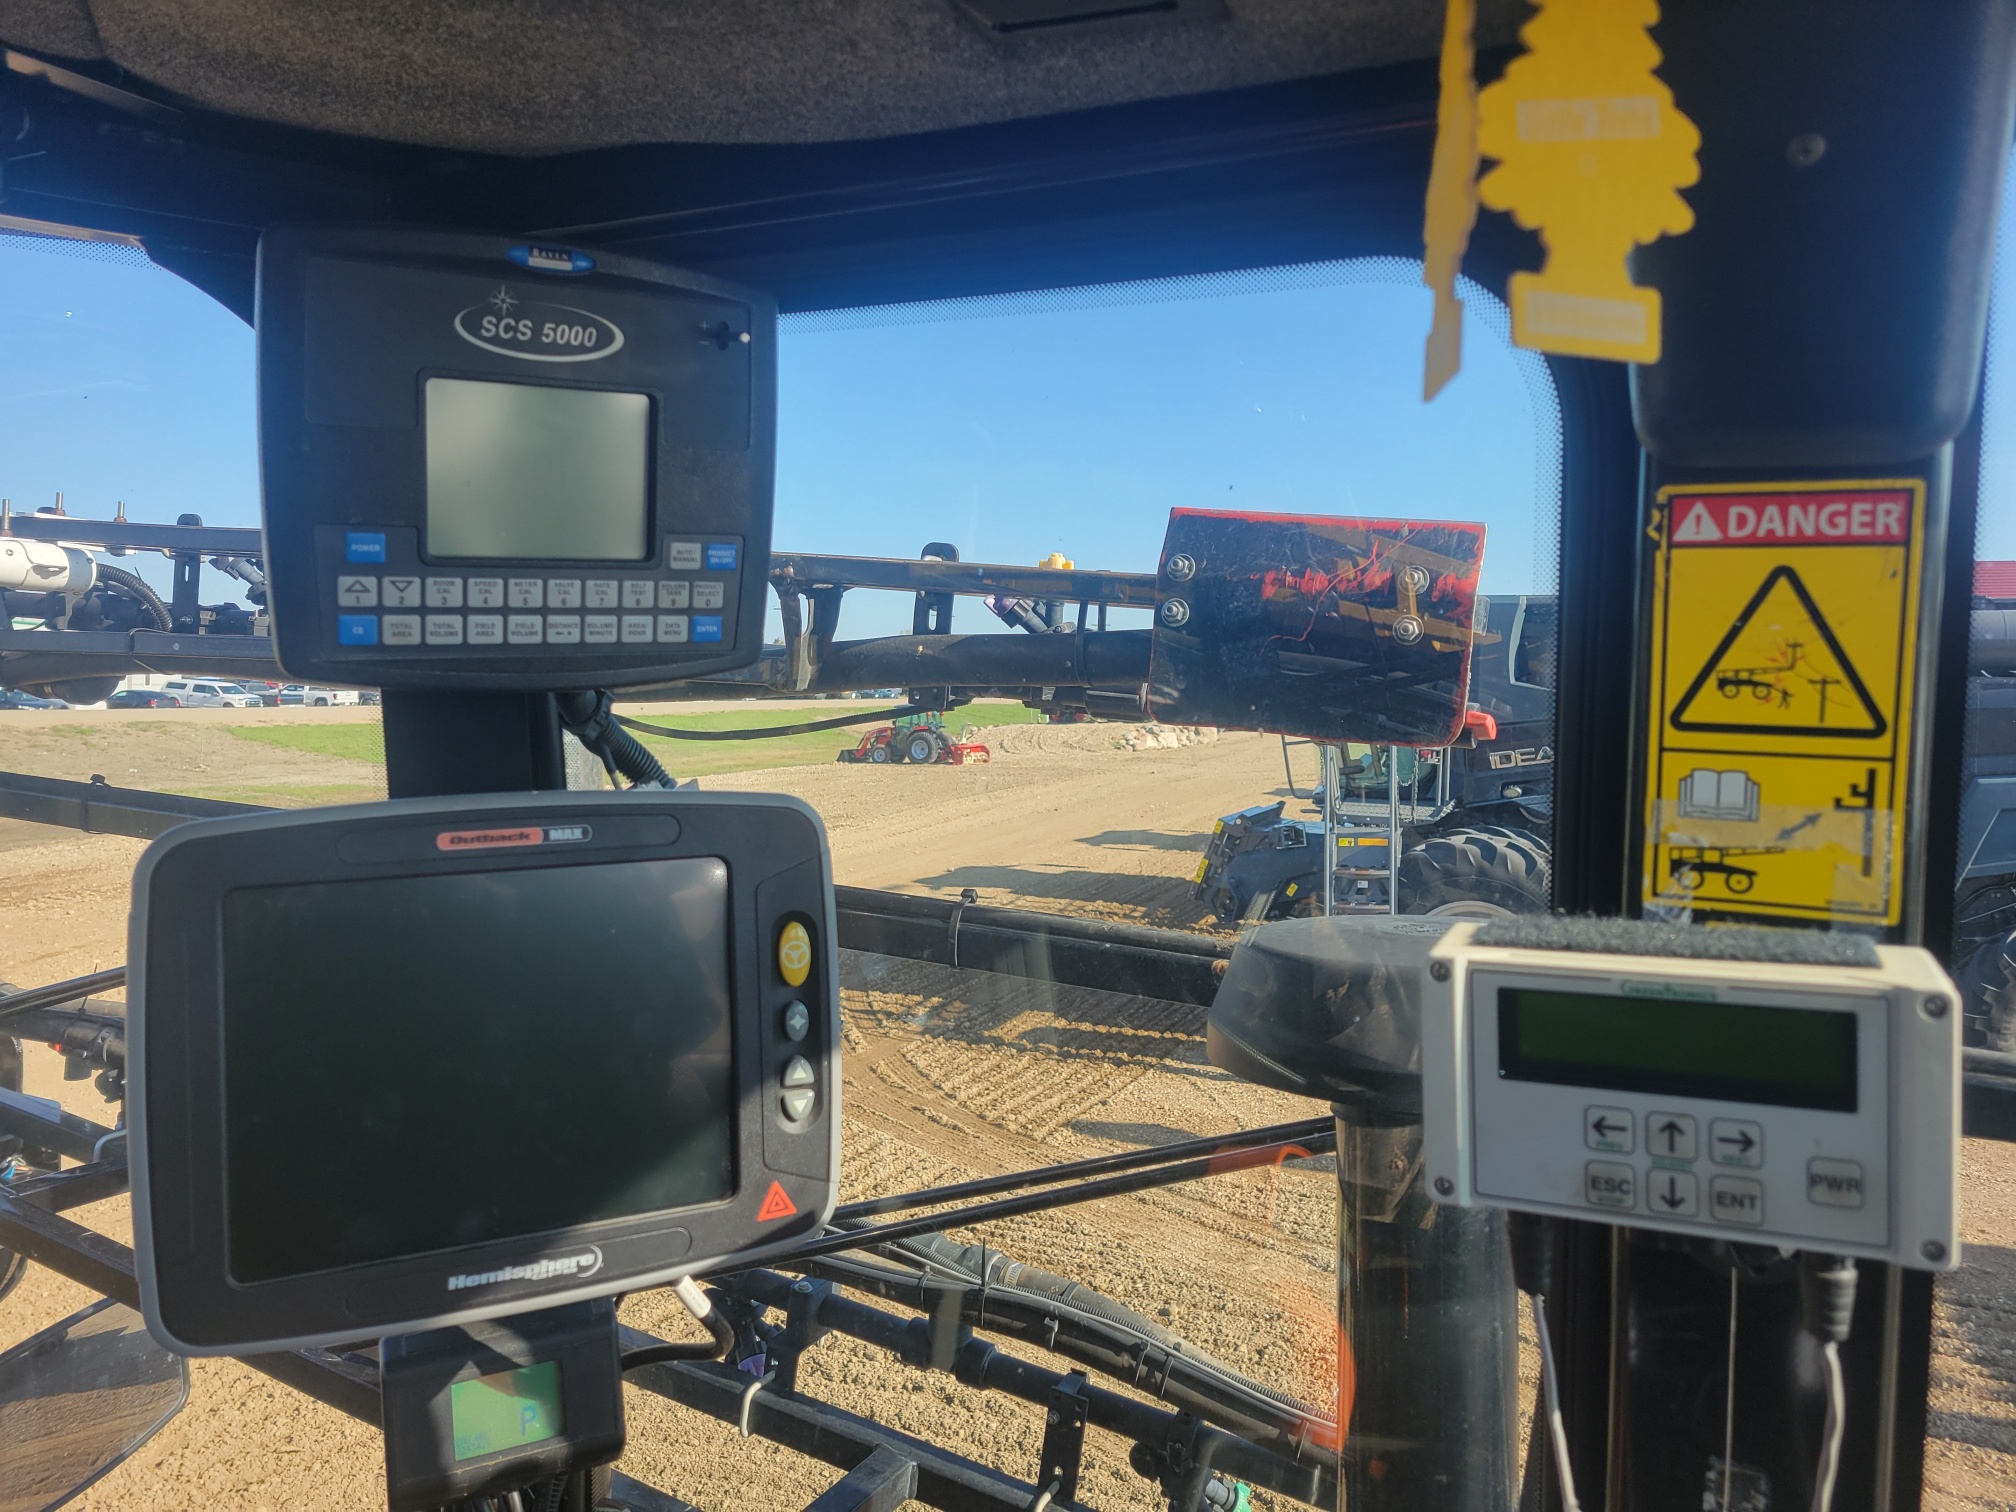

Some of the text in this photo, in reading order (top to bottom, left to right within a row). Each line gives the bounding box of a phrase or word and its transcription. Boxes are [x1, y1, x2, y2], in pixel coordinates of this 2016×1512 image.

[532, 247, 569, 261] RAVEN
[480, 315, 597, 348] SCS 5000
[1727, 502, 1902, 539] DANGER
[350, 542, 381, 553] POWER
[478, 587, 493, 595] CAL
[557, 588, 572, 596] CAL
[630, 589, 647, 597] TEST
[390, 622, 414, 630] TOTAL
[432, 622, 456, 630] TOTAL
[474, 622, 496, 630] FIELD
[697, 625, 718, 633] ENTER
[449, 827, 584, 845] Outback MAX
[1591, 1176, 1632, 1195] ESC
[1810, 1172, 1862, 1193] PWR
[1715, 1190, 1758, 1210] ENT
[448, 1253, 595, 1290] Hemisphere
[521, 1405, 537, 1437] P
